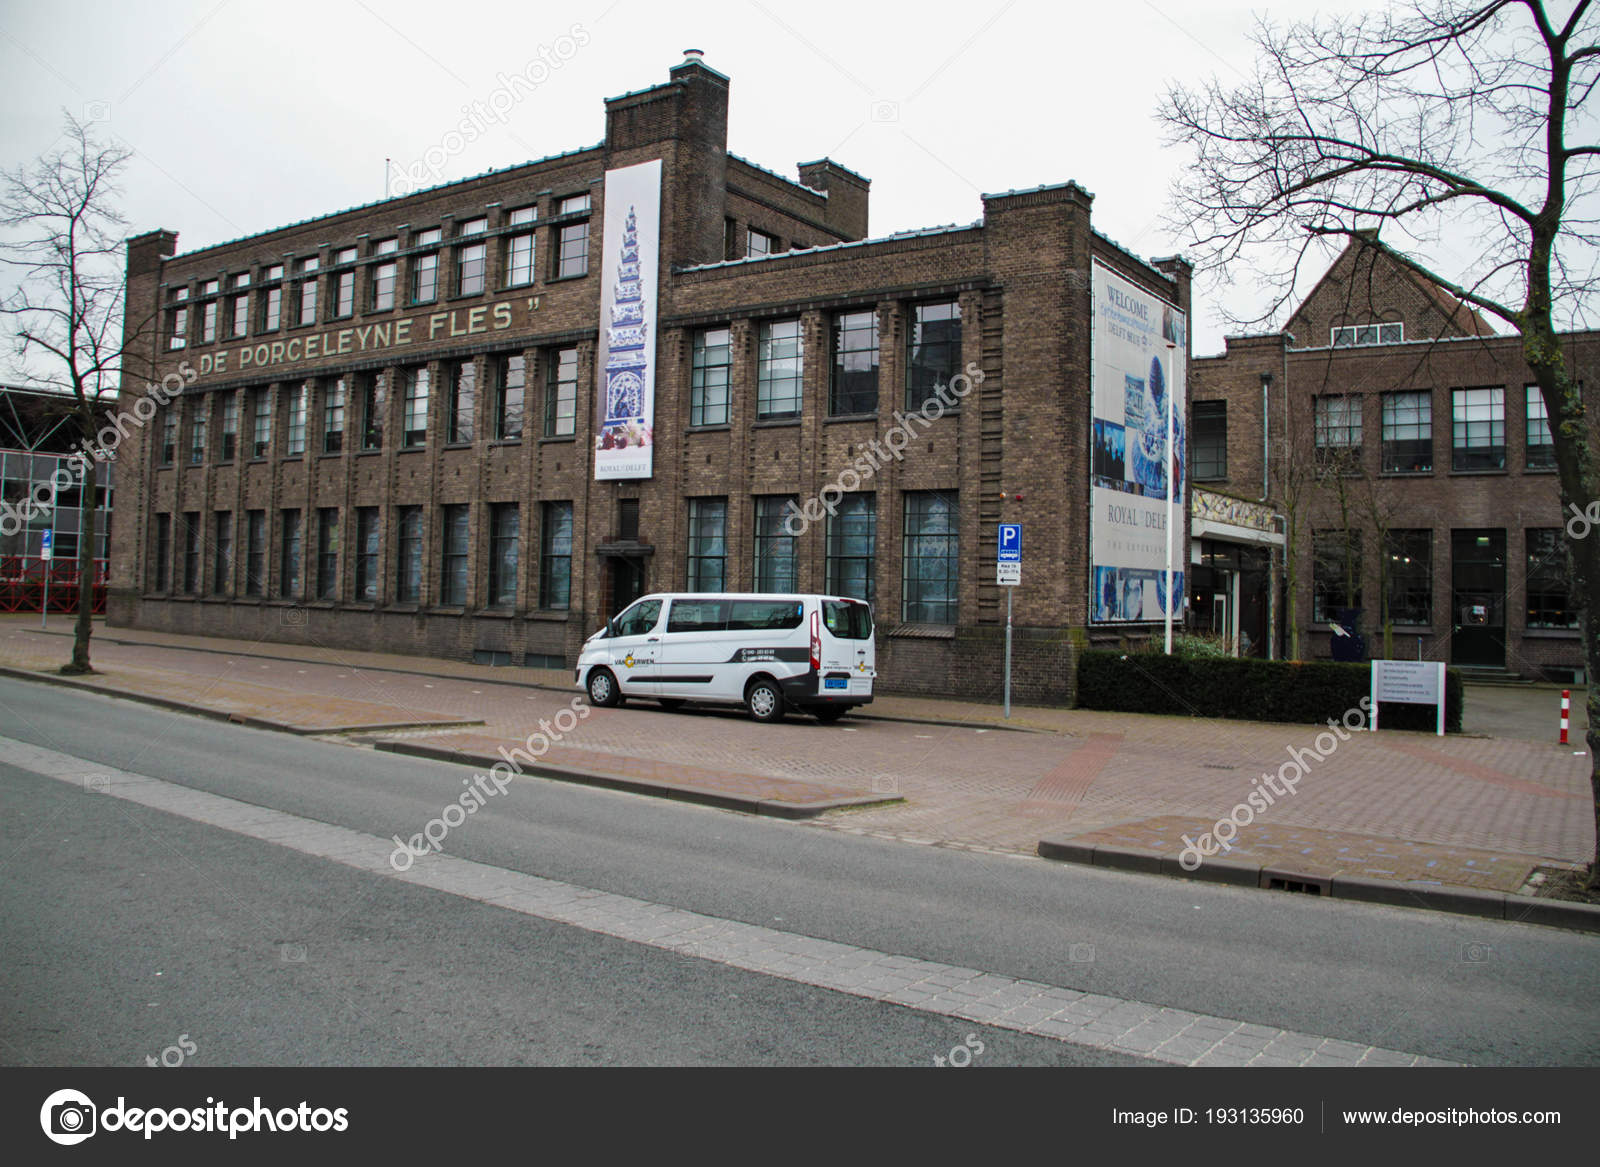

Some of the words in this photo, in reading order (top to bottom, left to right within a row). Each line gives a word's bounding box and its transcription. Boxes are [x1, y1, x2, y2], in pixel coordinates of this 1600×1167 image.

[1107, 285, 1148, 321] WELCOME
[200, 351, 227, 376] DE
[240, 318, 412, 370] PORCELEYNE
[429, 303, 511, 340] FLES
[1108, 504, 1138, 526] ROYAL
[1145, 511, 1167, 530] DELF
[1003, 527, 1016, 546] P
